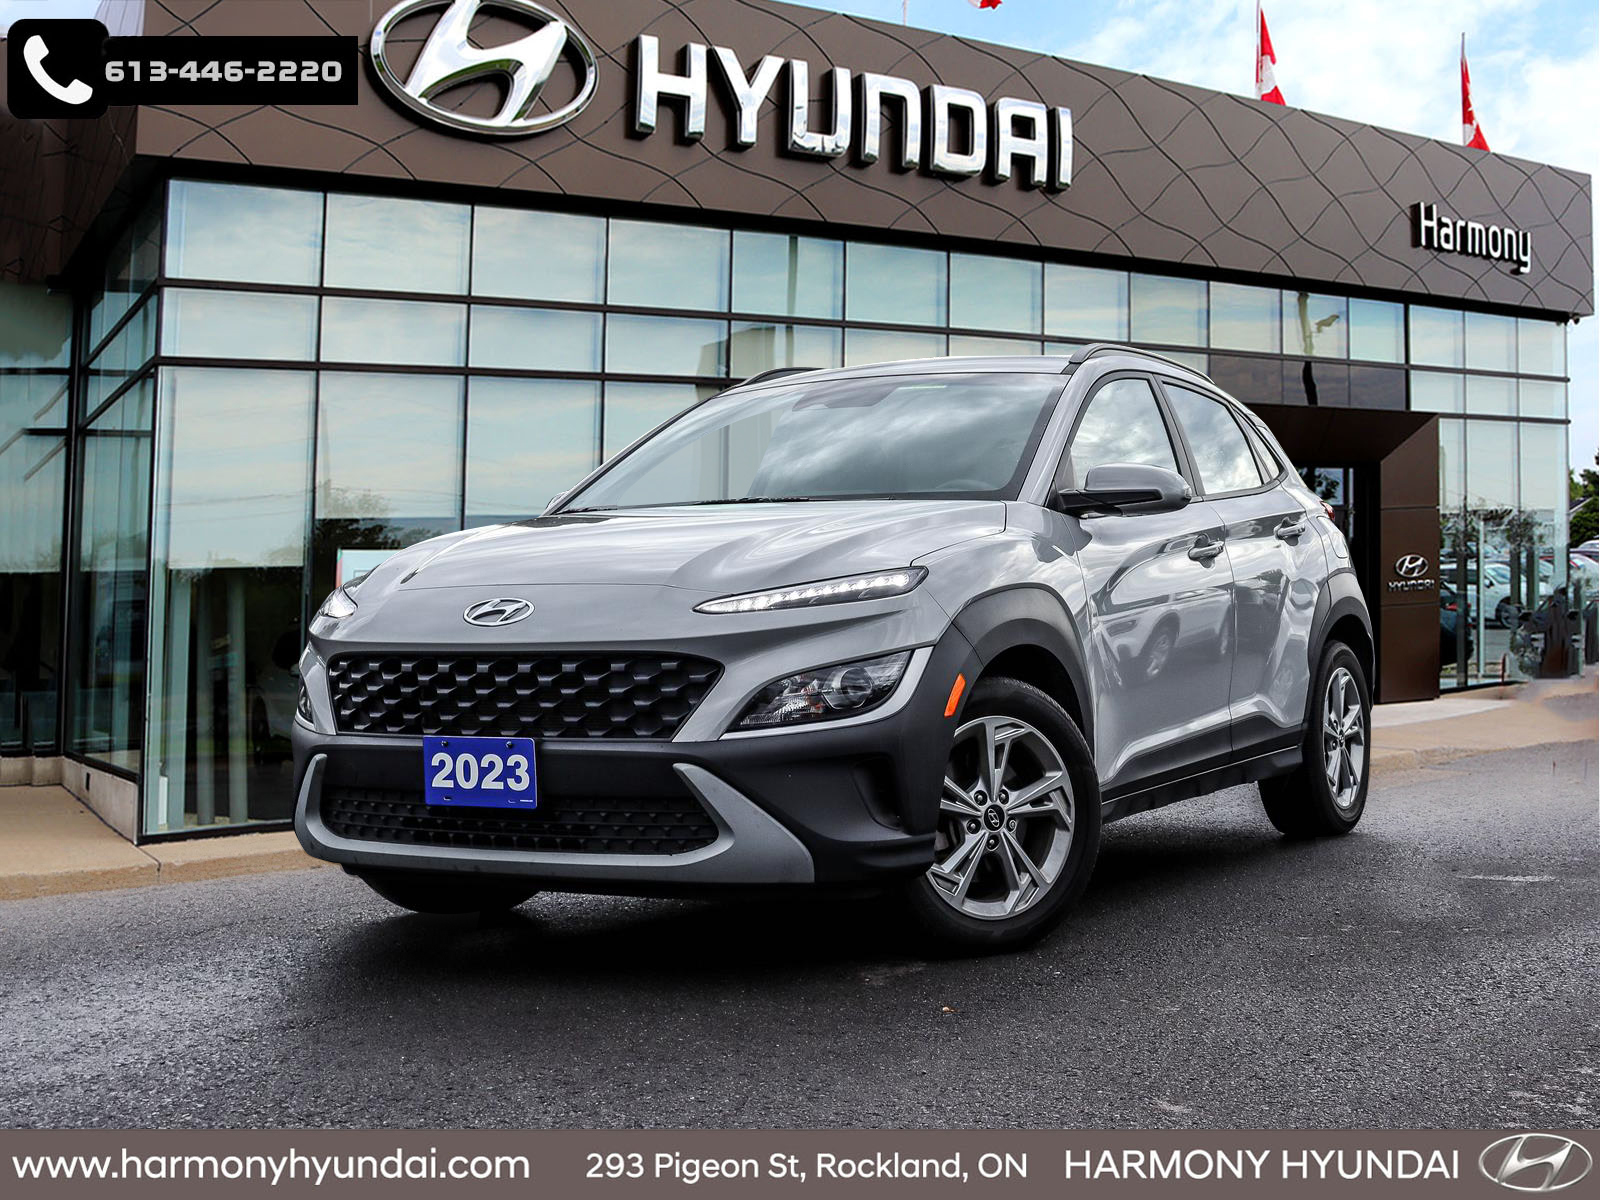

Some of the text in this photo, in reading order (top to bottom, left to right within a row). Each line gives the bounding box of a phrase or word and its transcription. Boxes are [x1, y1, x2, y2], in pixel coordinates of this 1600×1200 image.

[635, 33, 1074, 191] HYUNDAI
[1419, 201, 1532, 274] Harmony
[1388, 579, 1435, 592] HYUNDAI
[431, 752, 530, 791] 2023
